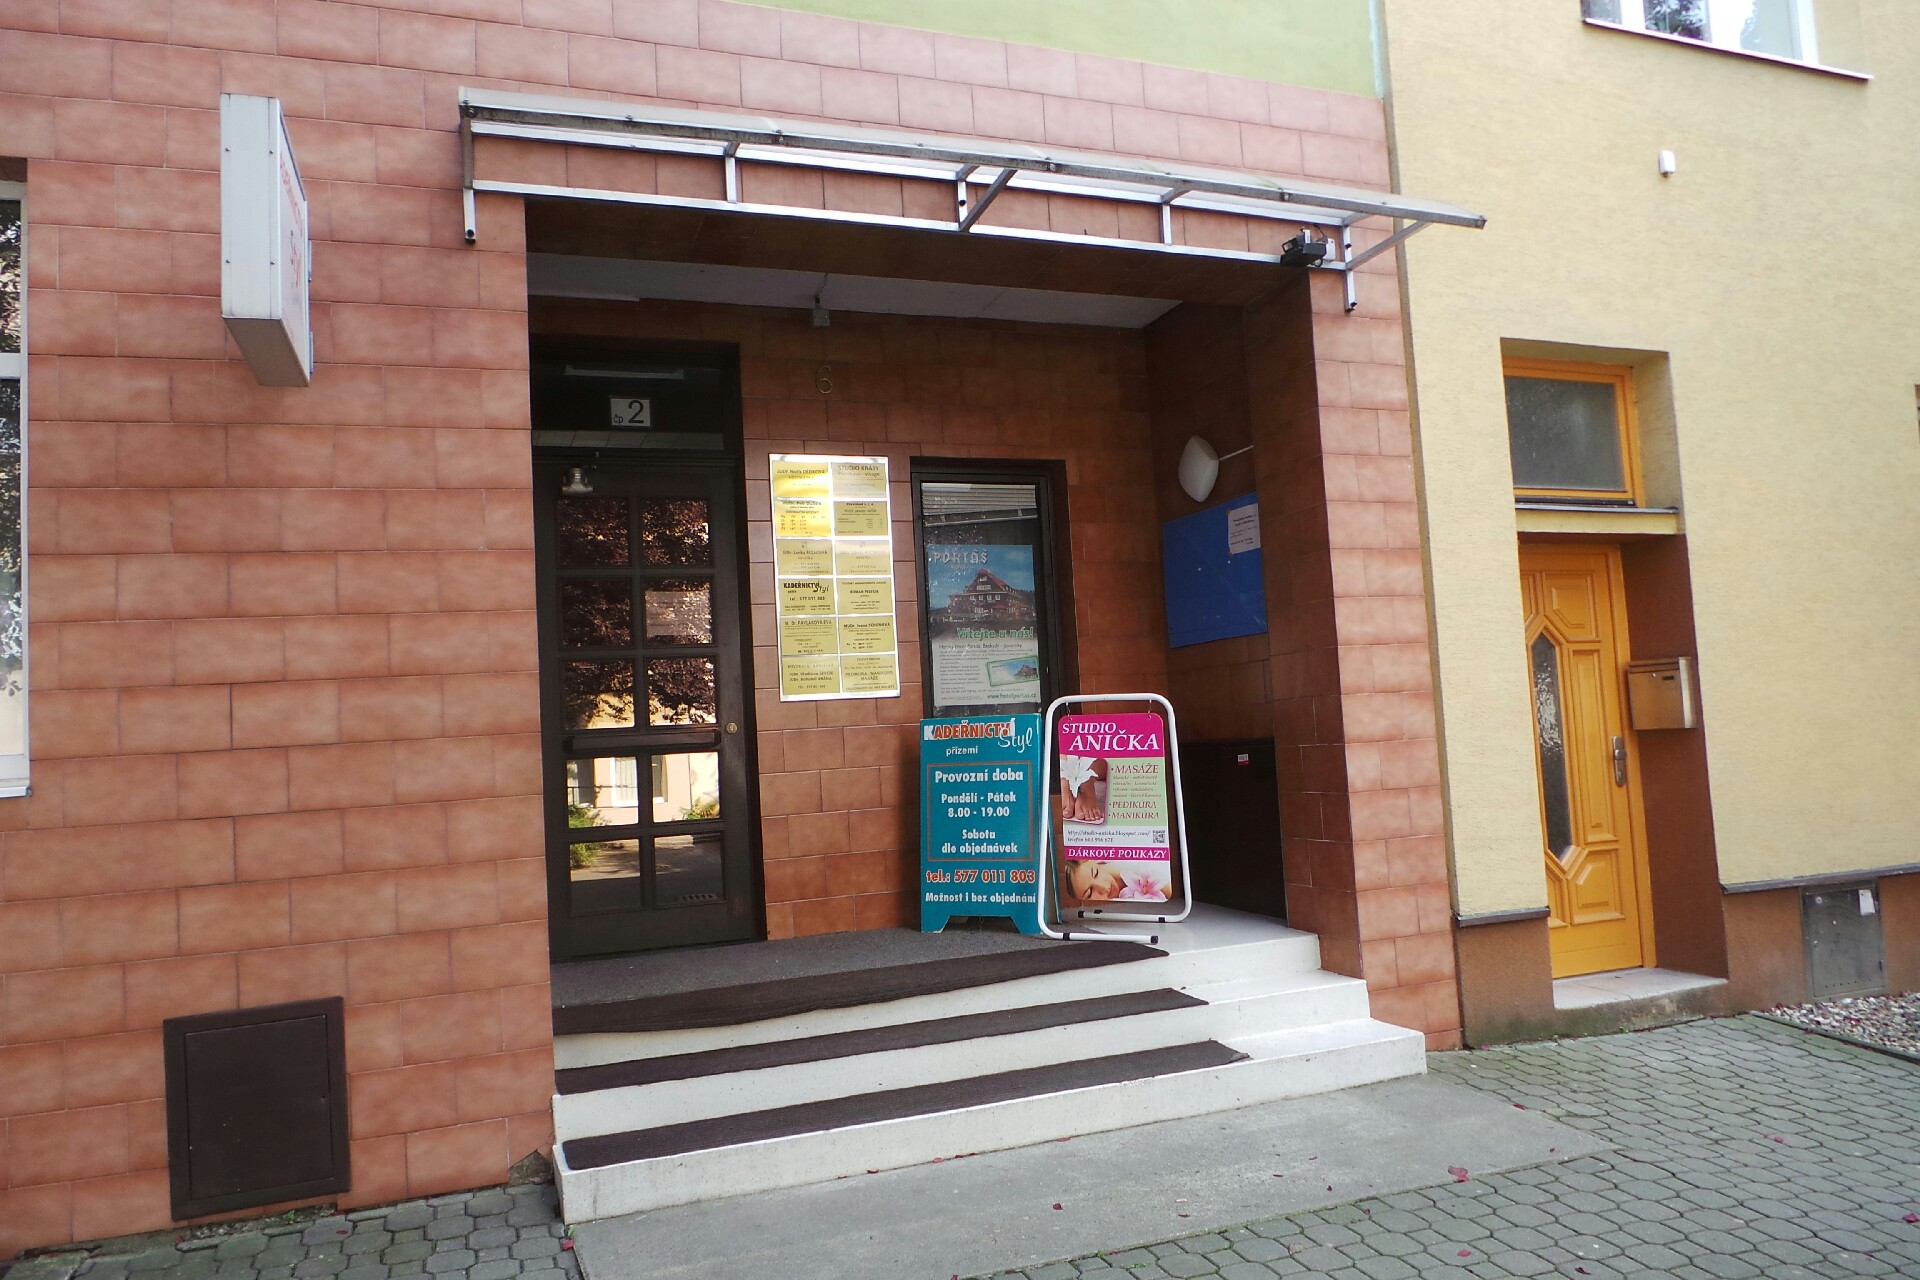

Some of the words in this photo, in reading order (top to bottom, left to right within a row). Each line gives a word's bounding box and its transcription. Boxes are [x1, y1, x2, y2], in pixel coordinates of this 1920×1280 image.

[816, 365, 833, 394] 6
[628, 400, 644, 424] 2
[957, 627, 996, 642] Vítejte
[999, 630, 1007, 638] u
[1010, 626, 1034, 638] nás!
[1062, 722, 1116, 734] STUDIO
[924, 718, 1016, 740] KADEŘNICTVÍ
[998, 727, 1033, 753] Styl
[1068, 729, 1160, 751] ANIČKA
[946, 746, 978, 756] přízemí
[1115, 762, 1158, 774] MASÁŽE
[935, 769, 988, 783] Provozní
[992, 768, 1024, 781] doba
[941, 792, 978, 803] Pondělí
[987, 791, 1016, 803] Pátek
[1112, 799, 1157, 808] PEDIKÚRA
[948, 808, 970, 817] 8.00
[981, 806, 1010, 817] 19.00
[1112, 811, 1159, 819] MANIKÚRA
[962, 829, 996, 839] Sobota
[942, 843, 956, 853] dle
[960, 842, 1018, 855] objednávek
[1068, 848, 1115, 858] DÁRKOVÉ
[1118, 850, 1166, 858] POUKAZY
[926, 869, 951, 882] tel.:
[954, 869, 978, 883] 577
[982, 870, 1006, 883] 011
[1010, 870, 1036, 883] 803
[926, 892, 963, 902] Možnost
[966, 892, 969, 902] i
[971, 892, 988, 902] bez
[990, 892, 1036, 905] objednání
